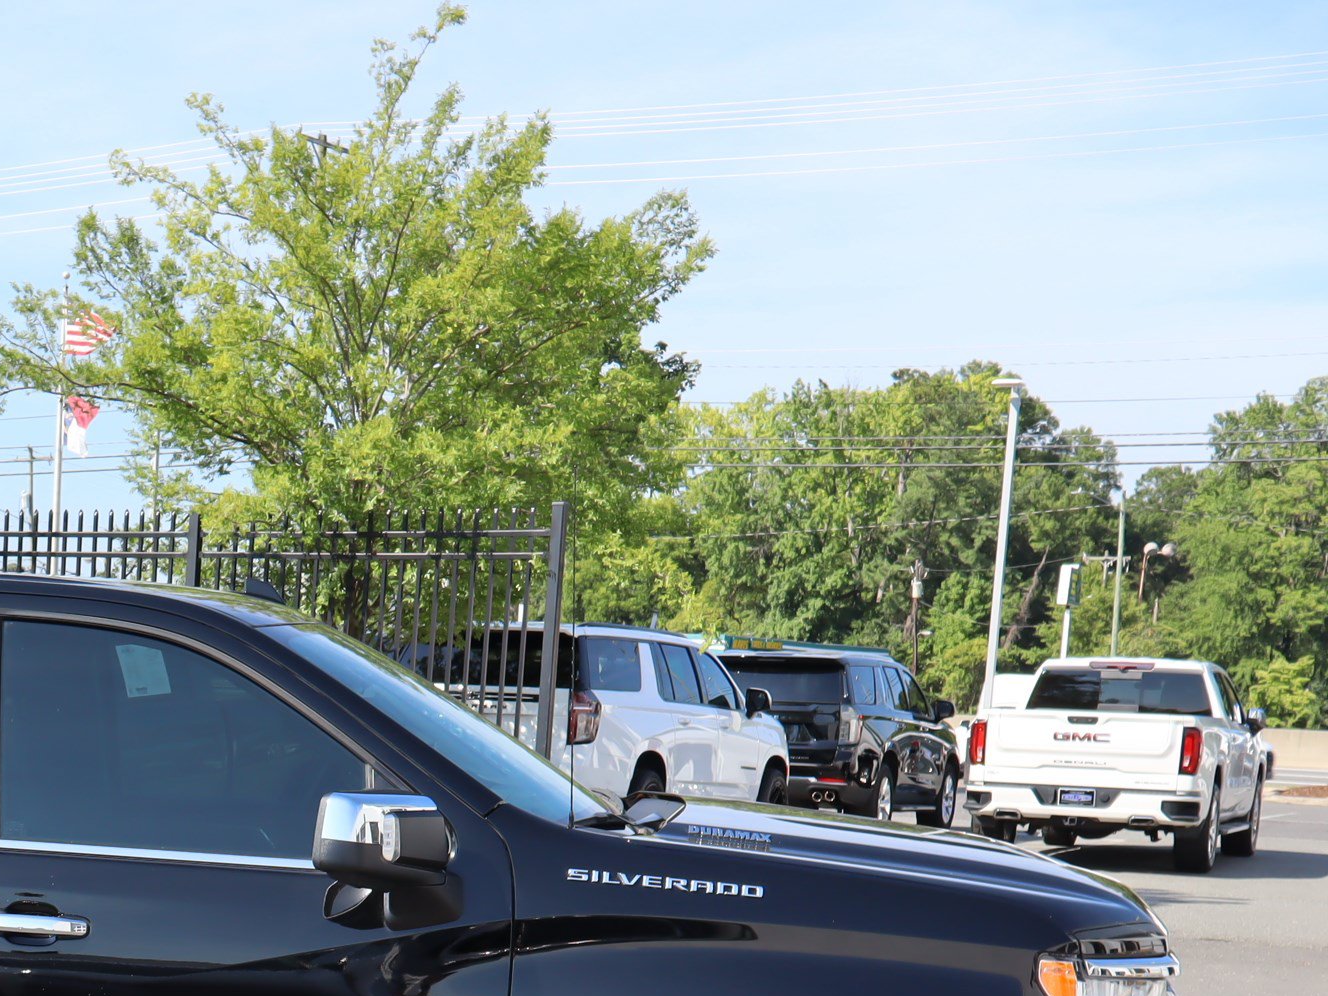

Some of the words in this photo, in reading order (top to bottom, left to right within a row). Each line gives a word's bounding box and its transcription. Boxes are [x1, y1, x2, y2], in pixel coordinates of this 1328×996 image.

[1053, 731, 1111, 743] GMC
[688, 825, 772, 843] DURAMAX
[566, 868, 764, 898] SILVERADO
